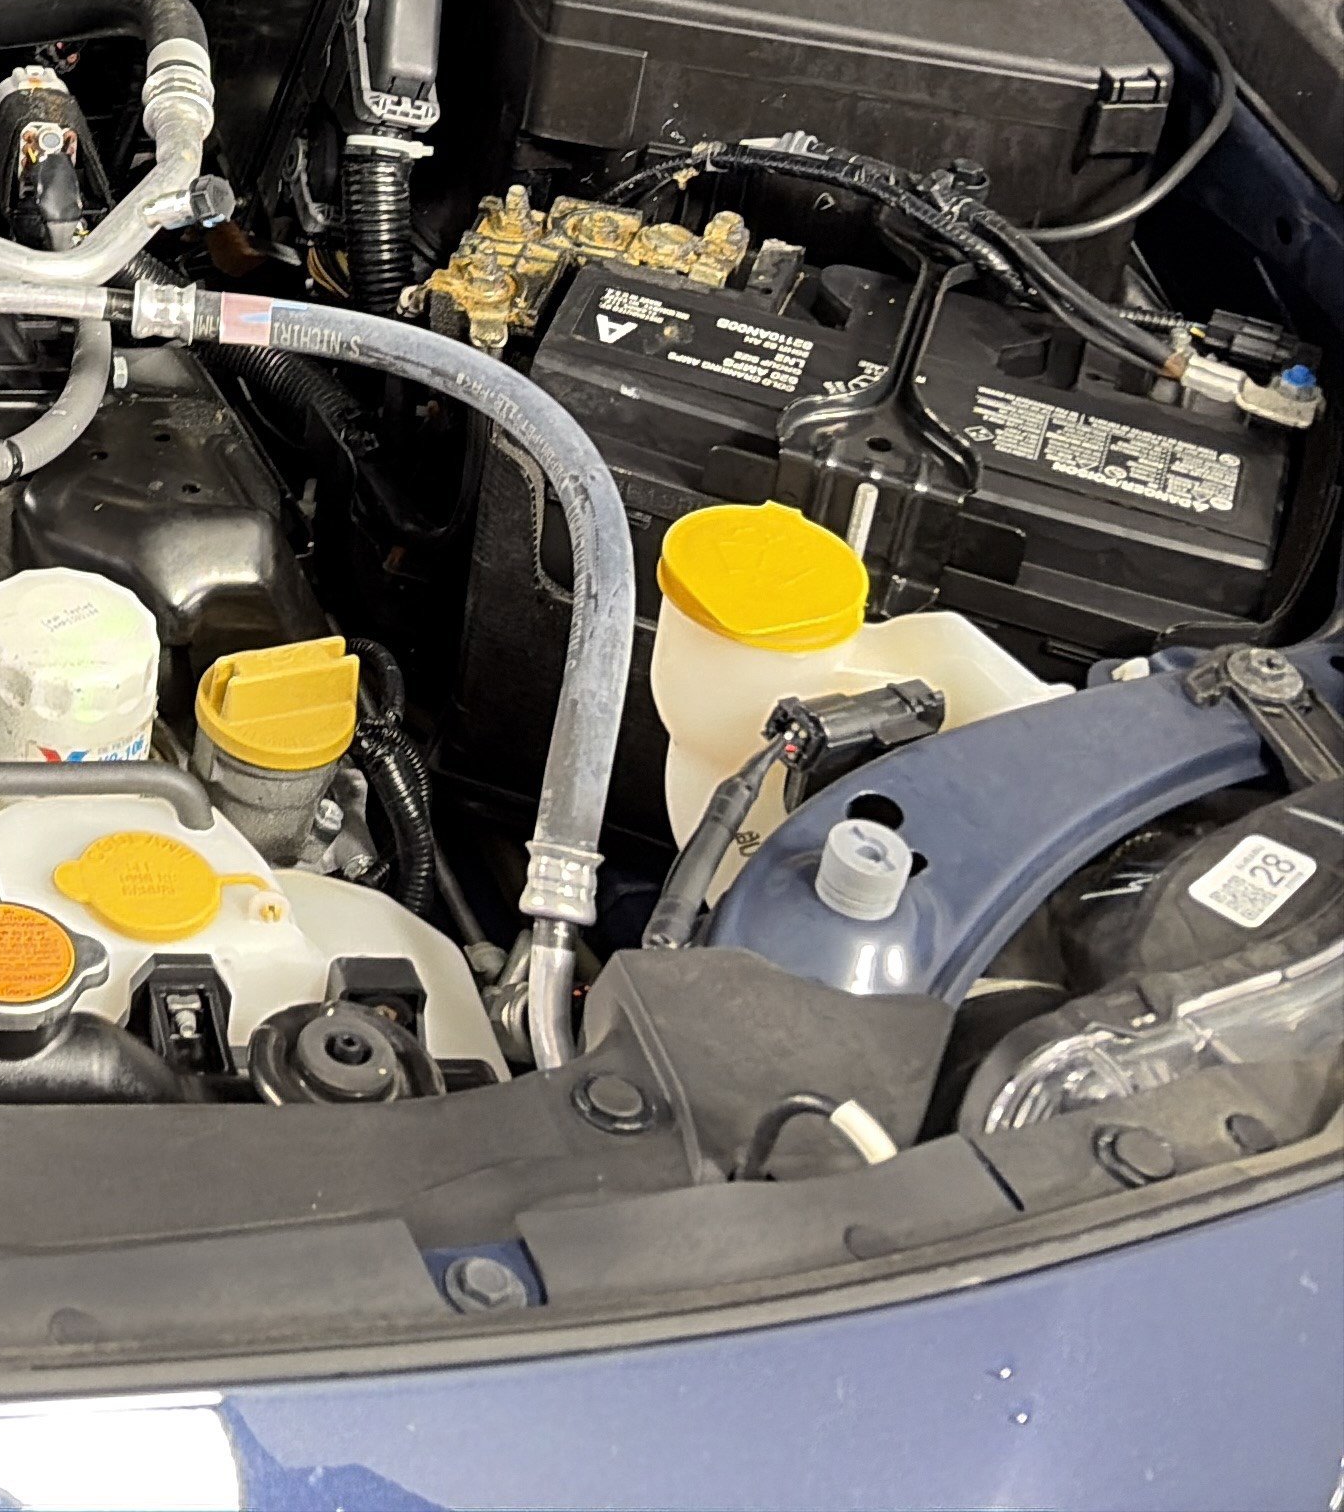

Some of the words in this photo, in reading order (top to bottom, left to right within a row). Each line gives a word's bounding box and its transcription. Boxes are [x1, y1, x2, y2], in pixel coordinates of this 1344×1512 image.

[667, 351, 701, 366] AMPS
[723, 358, 769, 377] AMPS
[759, 358, 803, 376] GROUP
[701, 360, 761, 383] CRANKING
[761, 376, 795, 392] COLD
[1250, 853, 1296, 887] 28
